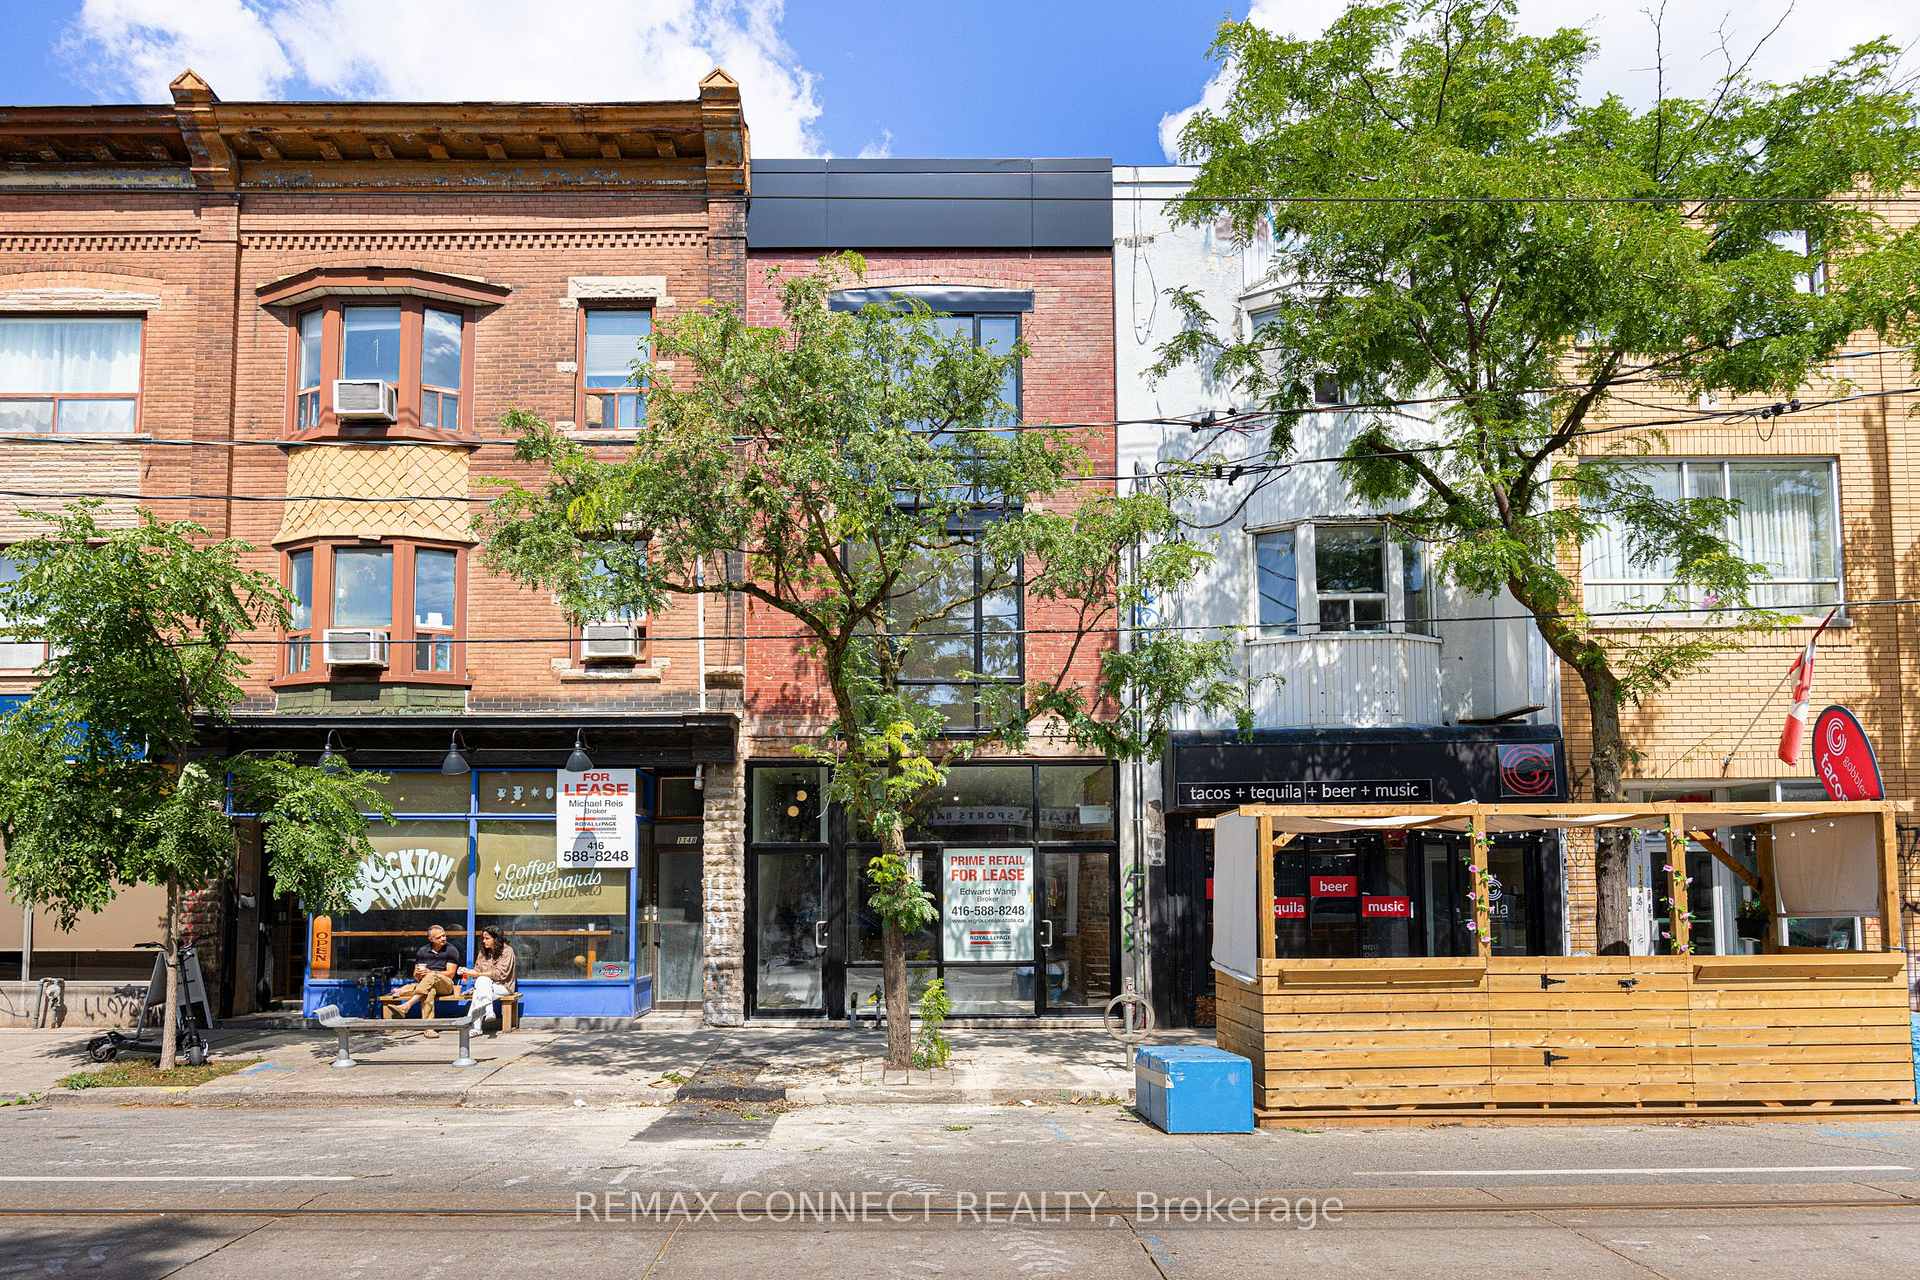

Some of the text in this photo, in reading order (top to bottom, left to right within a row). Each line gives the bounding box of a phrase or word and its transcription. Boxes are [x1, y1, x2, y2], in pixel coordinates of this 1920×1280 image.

[583, 772, 610, 781] FOR
[564, 783, 629, 796] LEASE
[1190, 786, 1231, 799] tacos
[1250, 784, 1302, 801] tequila
[1322, 783, 1357, 798] beer
[1375, 783, 1419, 797] music
[568, 799, 623, 808] Michael Reis
[587, 841, 604, 850] 416
[563, 850, 629, 862] 588-8248
[950, 855, 1025, 866] PRIME RETAIL
[504, 860, 556, 881] Coffee
[951, 869, 1025, 881] FOR LEASE
[495, 870, 602, 900] Skateboards
[1319, 880, 1348, 893] beer
[378, 875, 445, 909] HAUNT
[959, 888, 1017, 897] Edward Wang
[951, 905, 1025, 916] 416-588-8248
[1274, 902, 1305, 914] quila
[1368, 901, 1405, 912] music
[316, 931, 329, 962] OPEN
